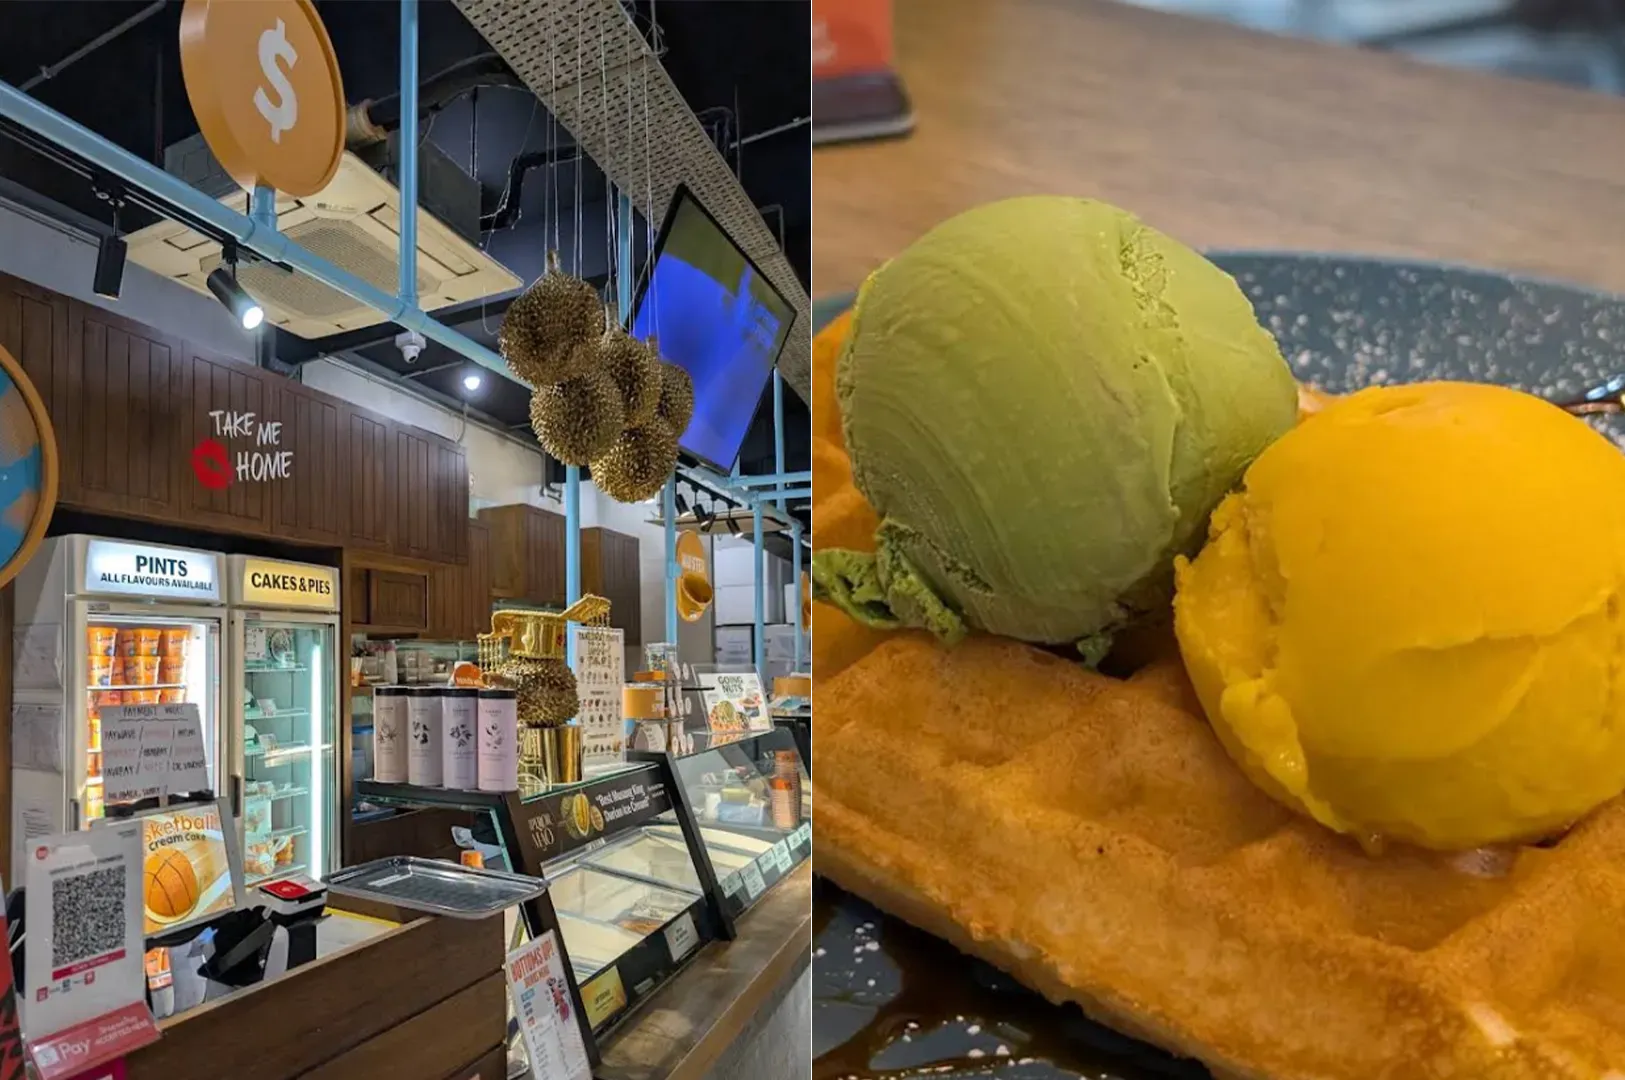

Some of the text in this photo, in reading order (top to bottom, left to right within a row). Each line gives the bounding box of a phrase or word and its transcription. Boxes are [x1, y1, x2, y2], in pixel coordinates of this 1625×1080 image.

[209, 411, 282, 446] TAKE ME
[236, 451, 293, 482] HOME
[136, 555, 188, 577] PINTS
[101, 573, 214, 591] ALL FLAVOURS AVAILABLE
[718, 676, 743, 685] GOING
[722, 683, 744, 693] NUTS
[149, 834, 184, 851] cream
[58, 1039, 91, 1061] Pay
